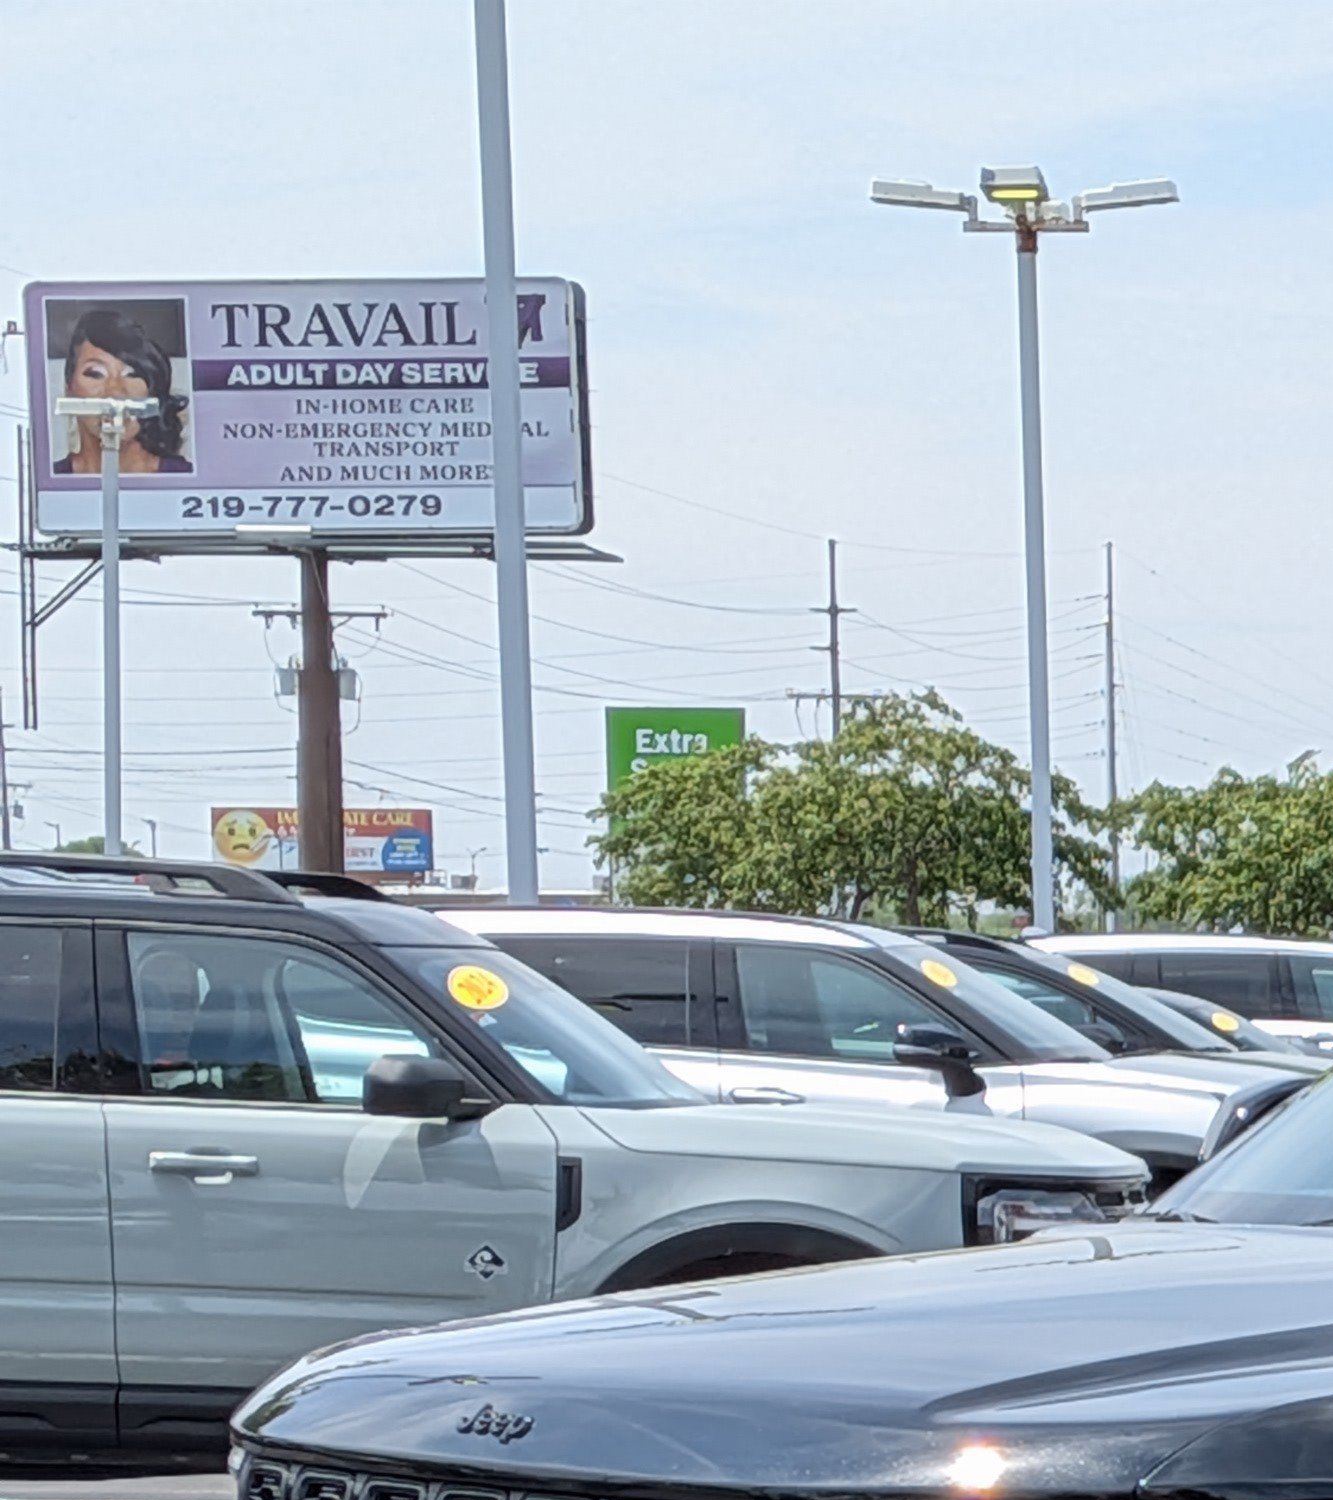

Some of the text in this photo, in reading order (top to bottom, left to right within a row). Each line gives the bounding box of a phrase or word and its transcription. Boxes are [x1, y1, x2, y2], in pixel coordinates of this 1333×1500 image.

[211, 302, 476, 347] TRAVAIL
[227, 362, 539, 386] ADULT DAY SERVE
[297, 398, 474, 414] IN-HOME CARE
[223, 421, 549, 439] NON-EMERGENCY MEDAL
[313, 441, 460, 457] TRANSPORT
[281, 466, 332, 482] AND
[340, 465, 411, 481] MUCH
[181, 494, 442, 519] 219-777-0279
[635, 728, 708, 754] Extra
[457, 1403, 535, 1446] Jeep
